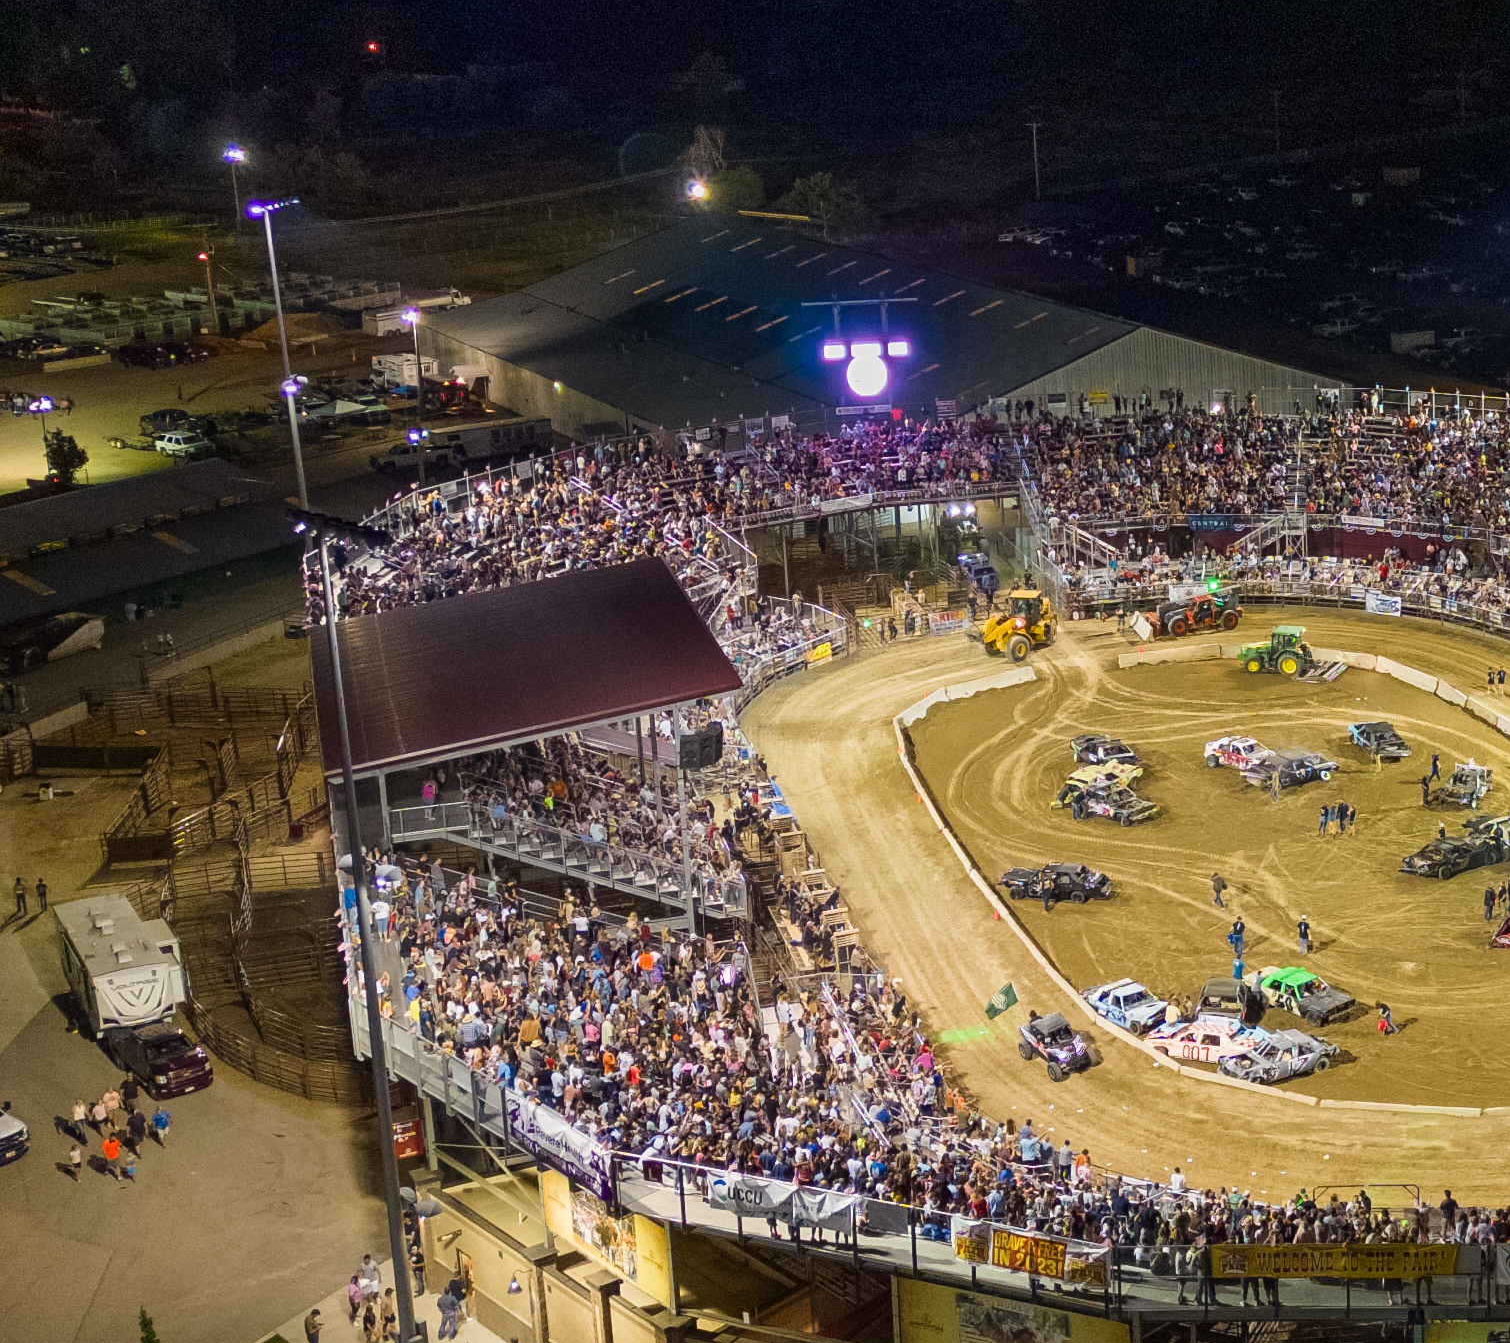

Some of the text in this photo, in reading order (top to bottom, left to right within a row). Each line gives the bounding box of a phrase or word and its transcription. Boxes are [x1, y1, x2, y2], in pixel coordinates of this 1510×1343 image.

[1183, 1045, 1209, 1061] 007
[535, 1125, 561, 1149] Revere
[728, 1188, 763, 1205] UCCU
[994, 1231, 1026, 1253] BRAVE
[994, 1249, 1010, 1266] IN
[1257, 1251, 1445, 1273] WELCOME TO THE FAIR!
